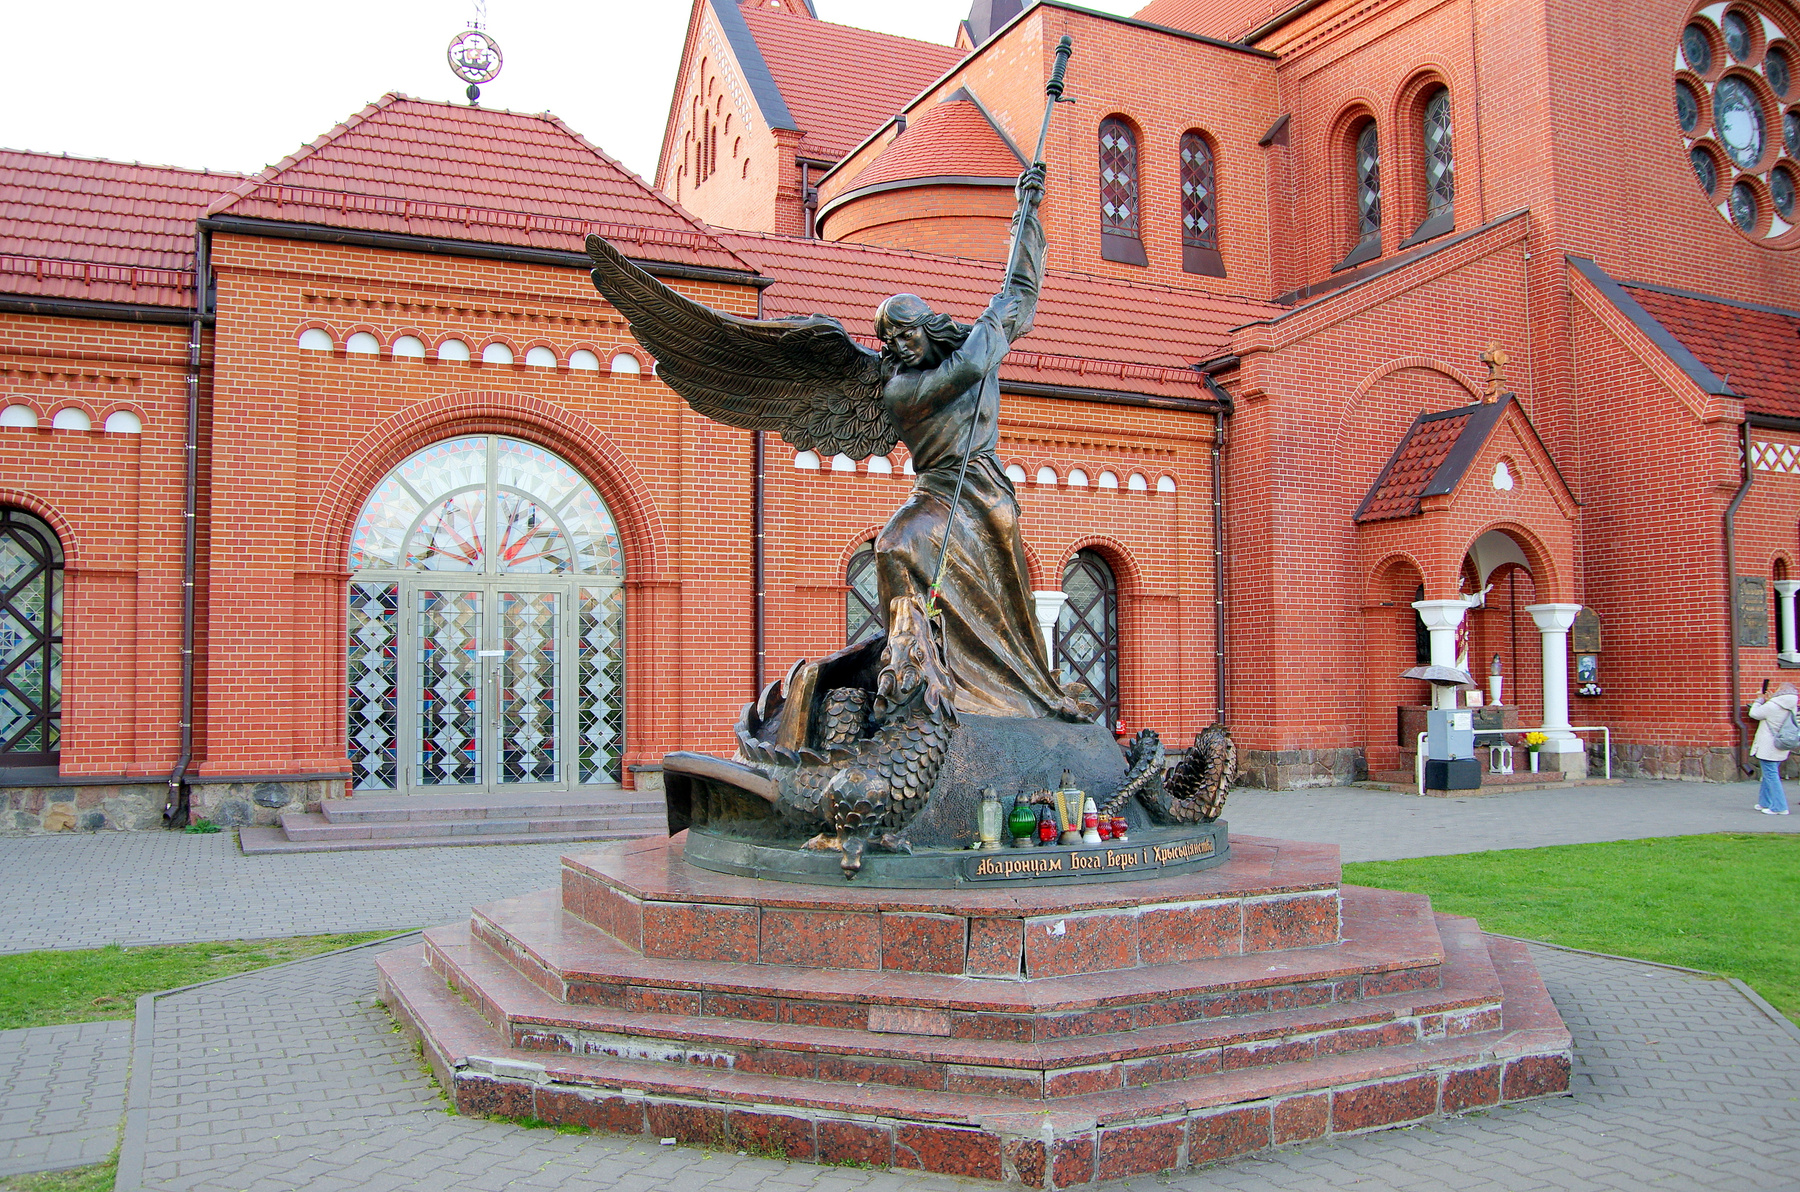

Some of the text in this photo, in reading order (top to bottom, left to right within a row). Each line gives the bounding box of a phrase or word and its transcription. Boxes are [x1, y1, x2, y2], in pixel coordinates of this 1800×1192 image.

[976, 858, 1062, 877] Абаронцам
[1070, 851, 1104, 870] Бога,
[1107, 849, 1138, 870] Веры
[1143, 848, 1148, 864] і
